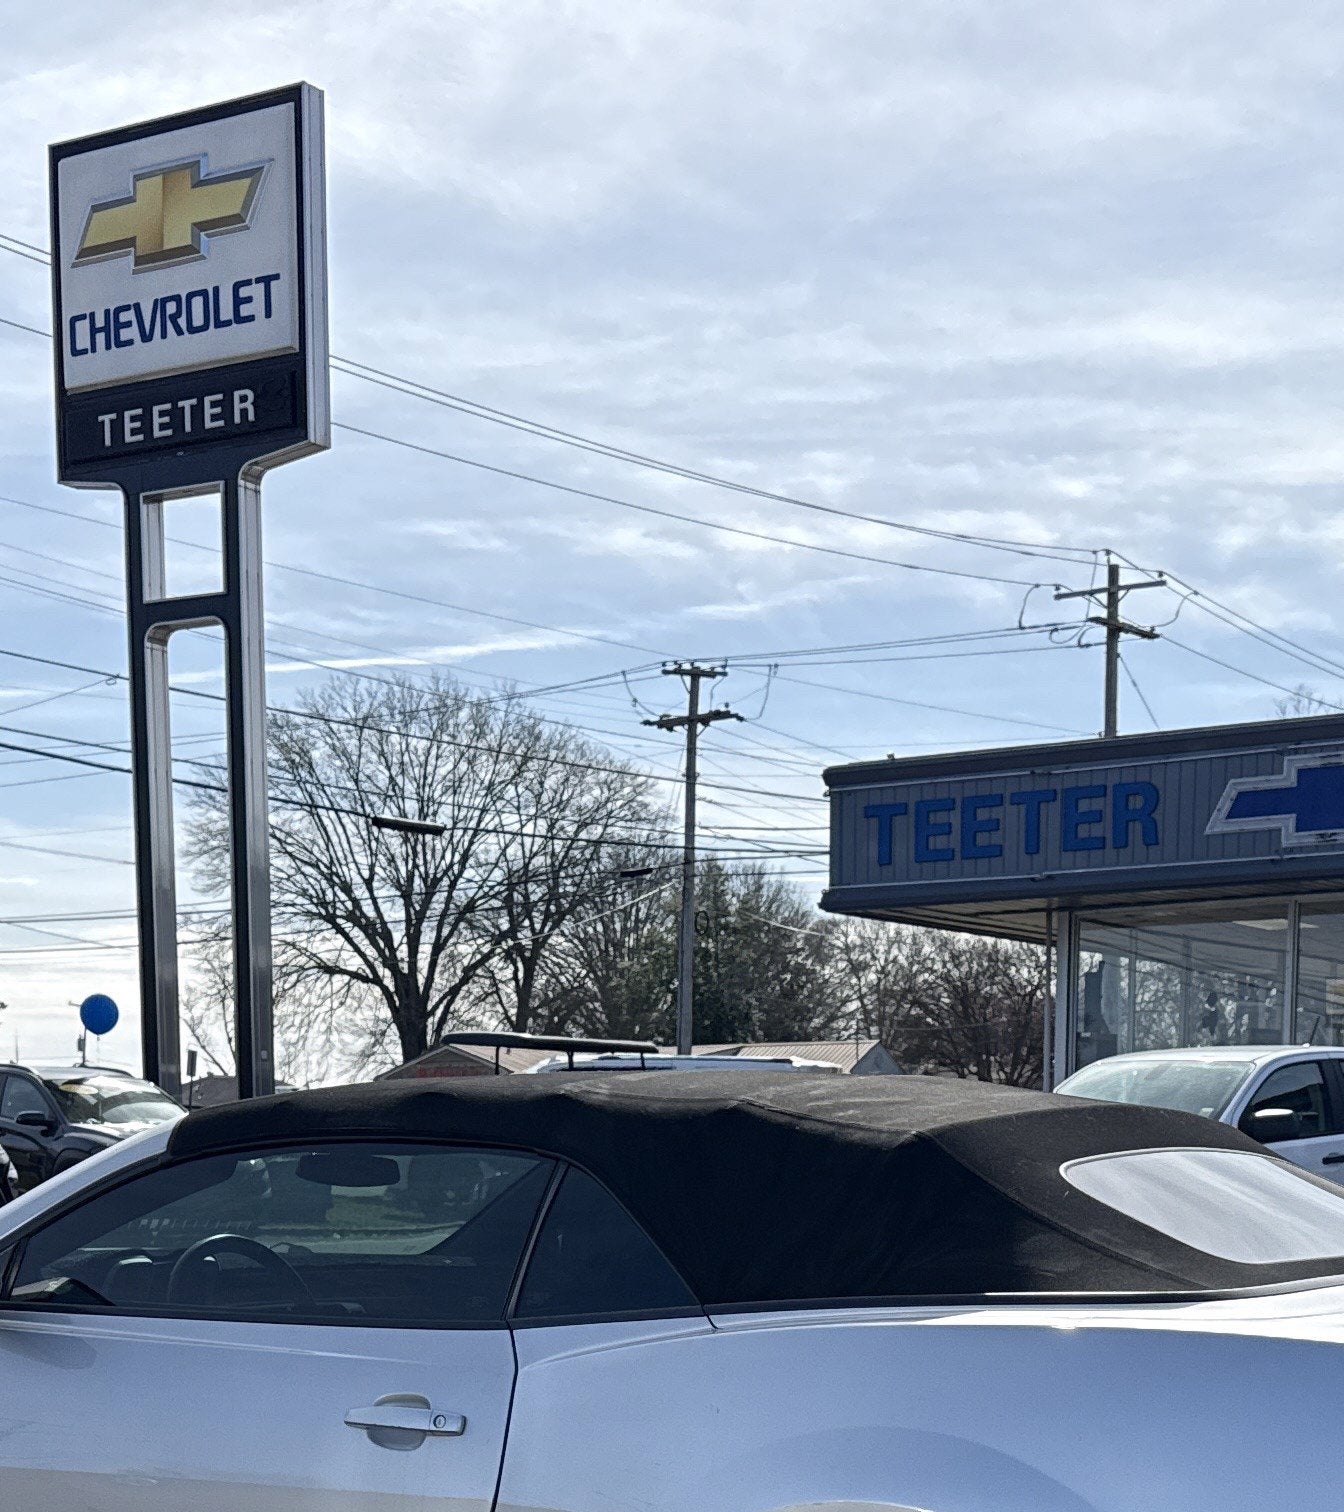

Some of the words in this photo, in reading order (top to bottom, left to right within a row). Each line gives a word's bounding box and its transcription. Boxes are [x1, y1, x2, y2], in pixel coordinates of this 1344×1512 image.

[69, 273, 281, 357] CHEVROLET
[97, 388, 257, 448] TEETER
[863, 781, 1161, 867] TEETER
